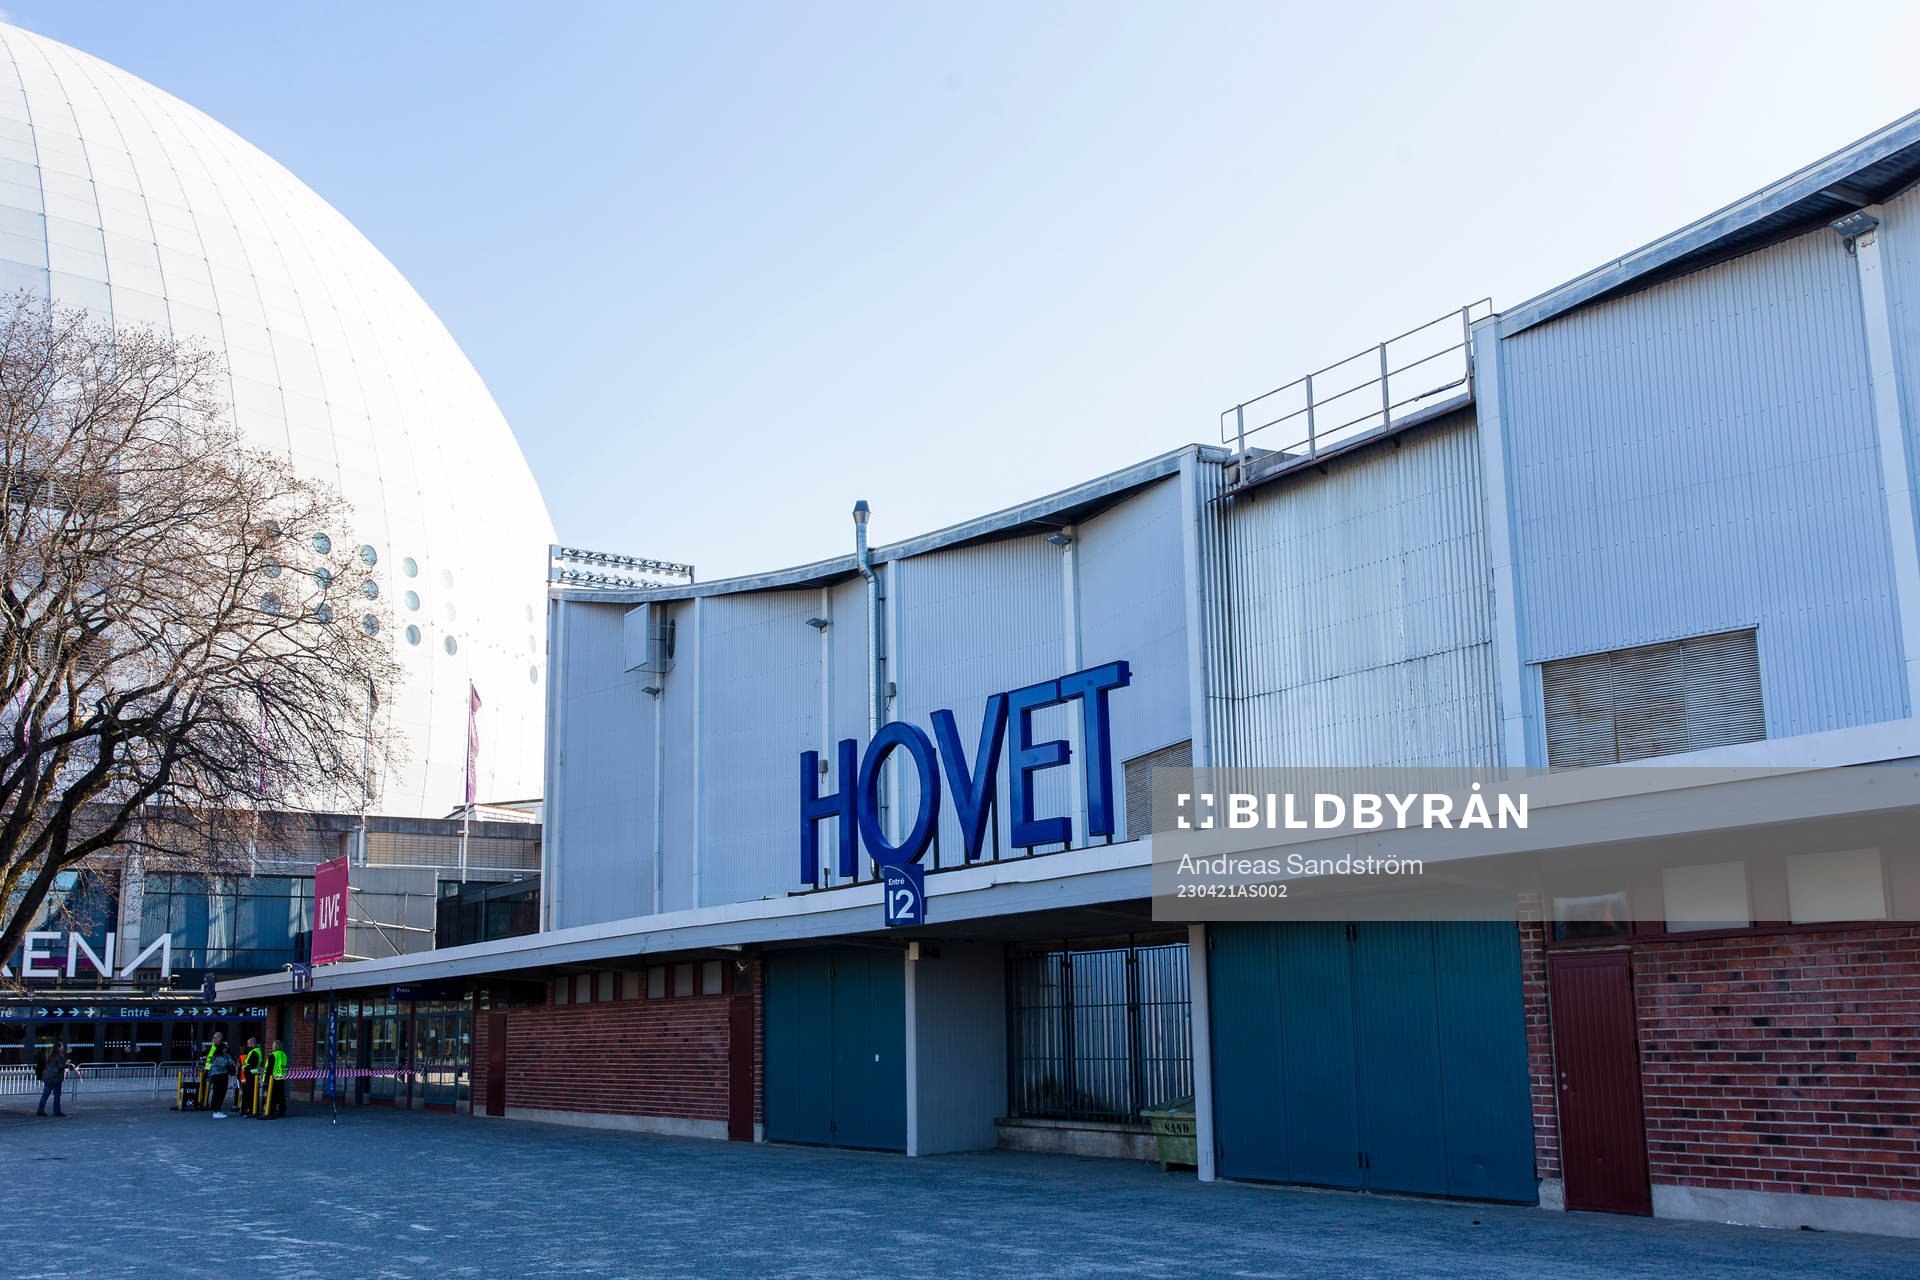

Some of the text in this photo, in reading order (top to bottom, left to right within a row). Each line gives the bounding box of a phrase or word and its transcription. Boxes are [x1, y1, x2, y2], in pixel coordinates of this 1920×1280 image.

[800, 660, 1130, 884] HOVET
[888, 877, 905, 886] Entré
[319, 893, 340, 930] LIVE
[888, 890, 915, 919] 12
[0, 932, 171, 977] ENA
[120, 1007, 150, 1017] Entré
[1165, 1122, 1190, 1134] SAND
